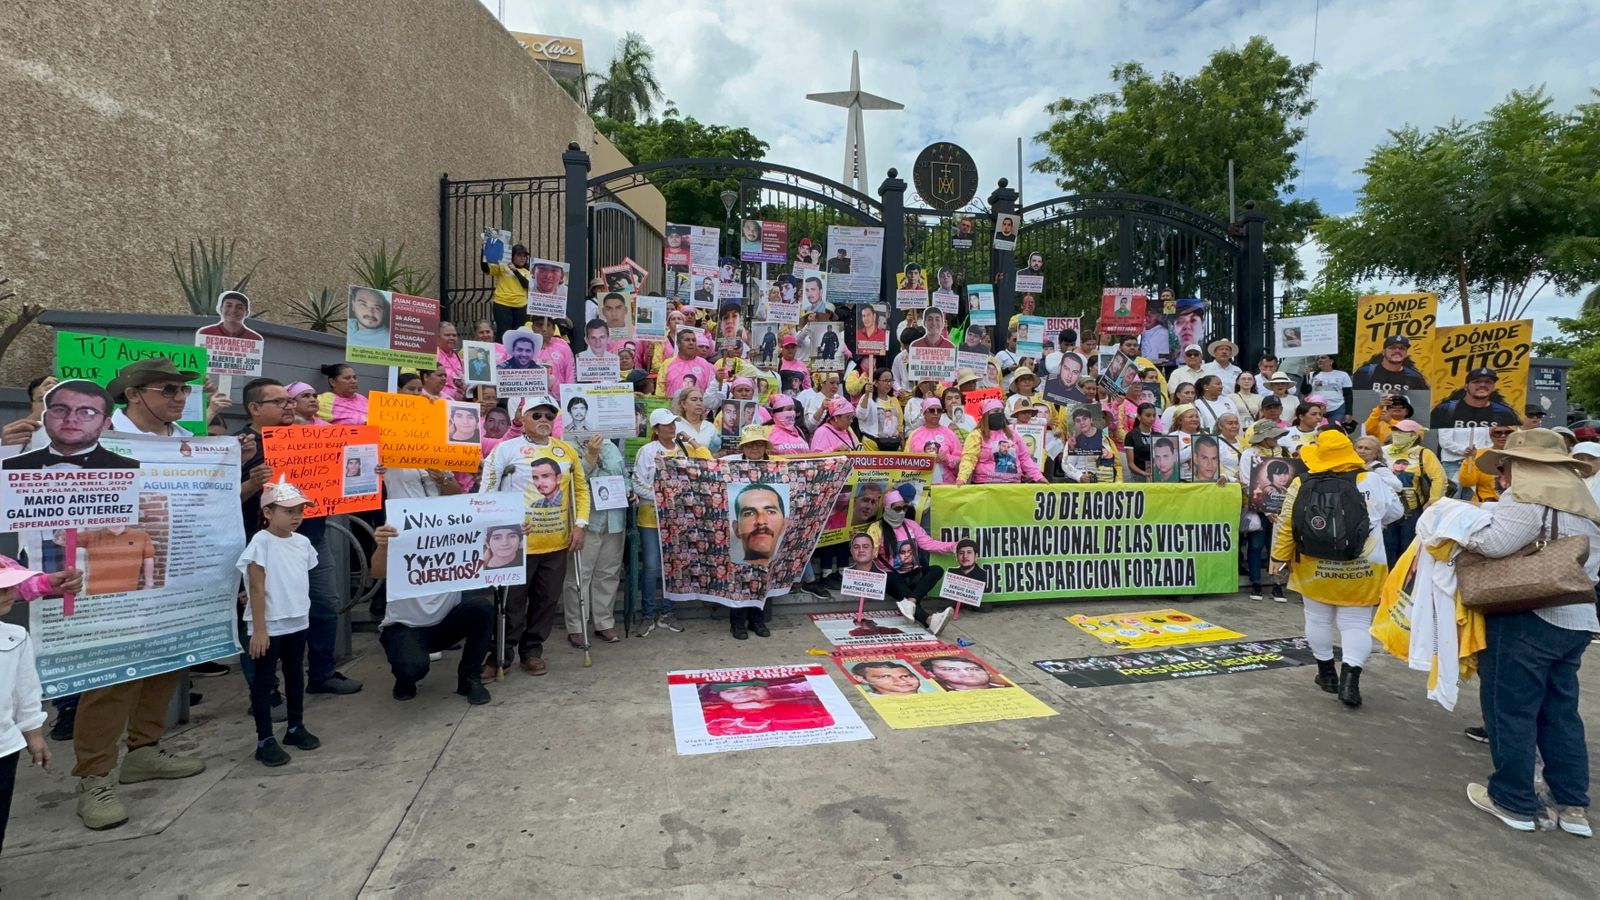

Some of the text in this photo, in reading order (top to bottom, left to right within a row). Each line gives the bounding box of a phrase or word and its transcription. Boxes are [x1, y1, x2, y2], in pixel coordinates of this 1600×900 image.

[394, 297, 437, 309] JUAN CARLOS
[1364, 296, 1429, 320] ¿DÓNDE
[403, 315, 421, 323] AÑOS
[1047, 318, 1079, 330] BUSCA
[1366, 314, 1436, 342] TITO?
[206, 336, 256, 348] DESAPARECIDO
[1441, 324, 1521, 354] ¿DÓNDE
[74, 336, 107, 359] TÚ
[117, 342, 198, 369] AUSENCIA
[1444, 343, 1530, 377] TITO?
[61, 365, 103, 379] DOLOR
[404, 429, 432, 439] SIGUE
[381, 443, 430, 451] ALTANDO
[400, 456, 439, 465] ALBERTO
[444, 459, 476, 467] IBARRA
[879, 457, 894, 466] LOS
[895, 458, 931, 467] AMAMOS
[8, 472, 135, 482] DESAPARECIDO
[144, 481, 233, 491] AGUILAR RODRIGUEZ
[24, 493, 120, 505] MARIO ARISTEO
[1034, 489, 1144, 521] 30 DE AGOSTO
[6, 504, 133, 519] GALINDO GUTIERREZ
[9, 516, 130, 530] ¡ESPERAMOS TU REGRESO!
[976, 525, 1099, 558] INTERNACIONAL
[1104, 525, 1122, 555] DE
[1125, 523, 1152, 555] LAS
[1156, 522, 1231, 553] VICTIMAS
[983, 557, 1196, 593] DE DESAPARICION FORZADA
[843, 584, 865, 592] MARTINEZ
[854, 580, 874, 588] RICARDO
[832, 644, 959, 657] DESAPARECIDOS
